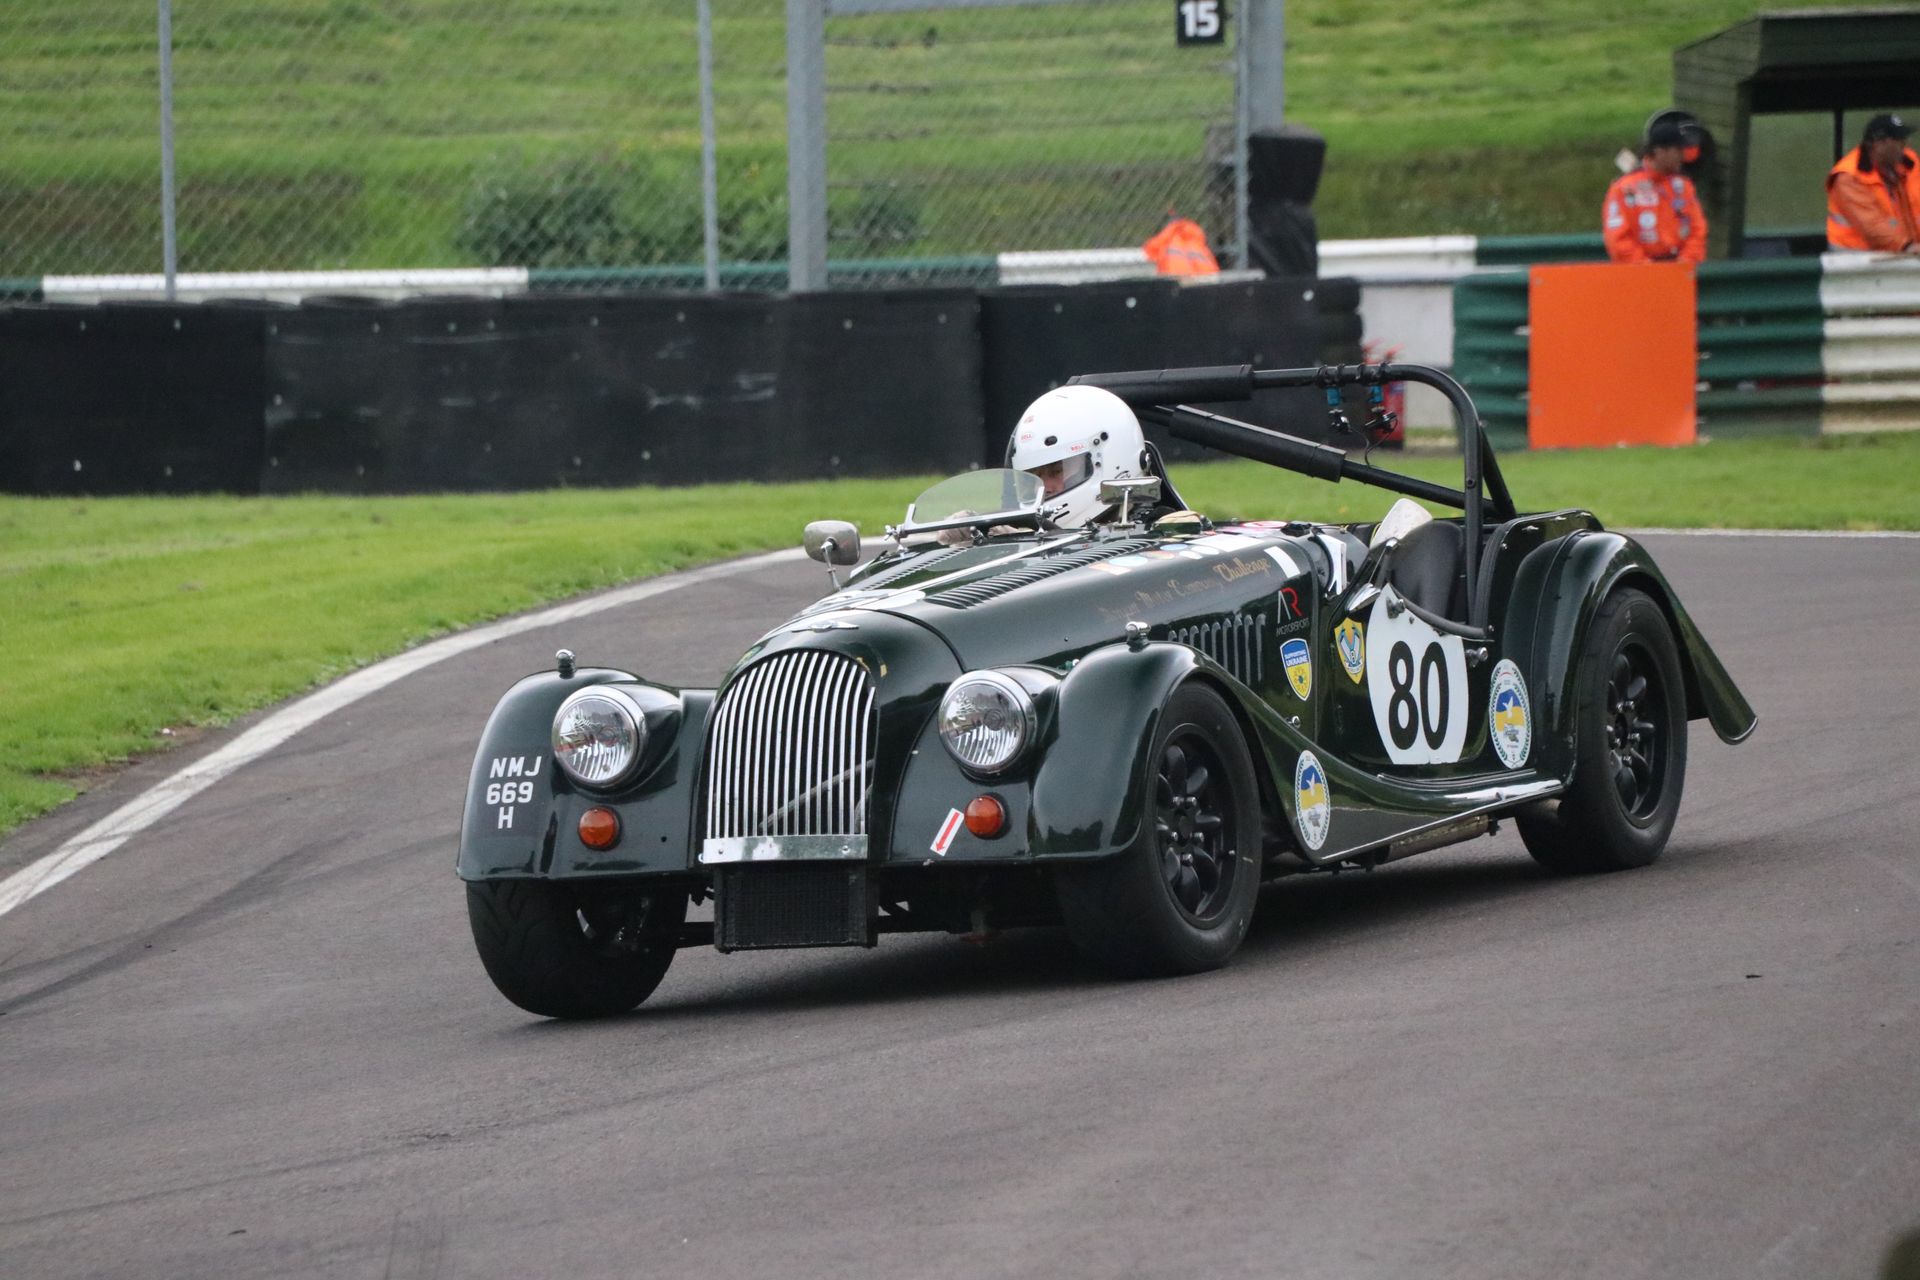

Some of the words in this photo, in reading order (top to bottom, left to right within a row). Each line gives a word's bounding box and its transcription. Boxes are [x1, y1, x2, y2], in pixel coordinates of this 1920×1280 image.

[1180, 0, 1220, 37] 15
[1213, 557, 1271, 582] Challenge
[1275, 617, 1310, 638] MOTORSPORT
[1285, 654, 1309, 668] UKRAINE
[1388, 640, 1450, 751] 80
[489, 756, 542, 779] NMJ
[486, 781, 533, 805] 669
[497, 806, 514, 830] H
